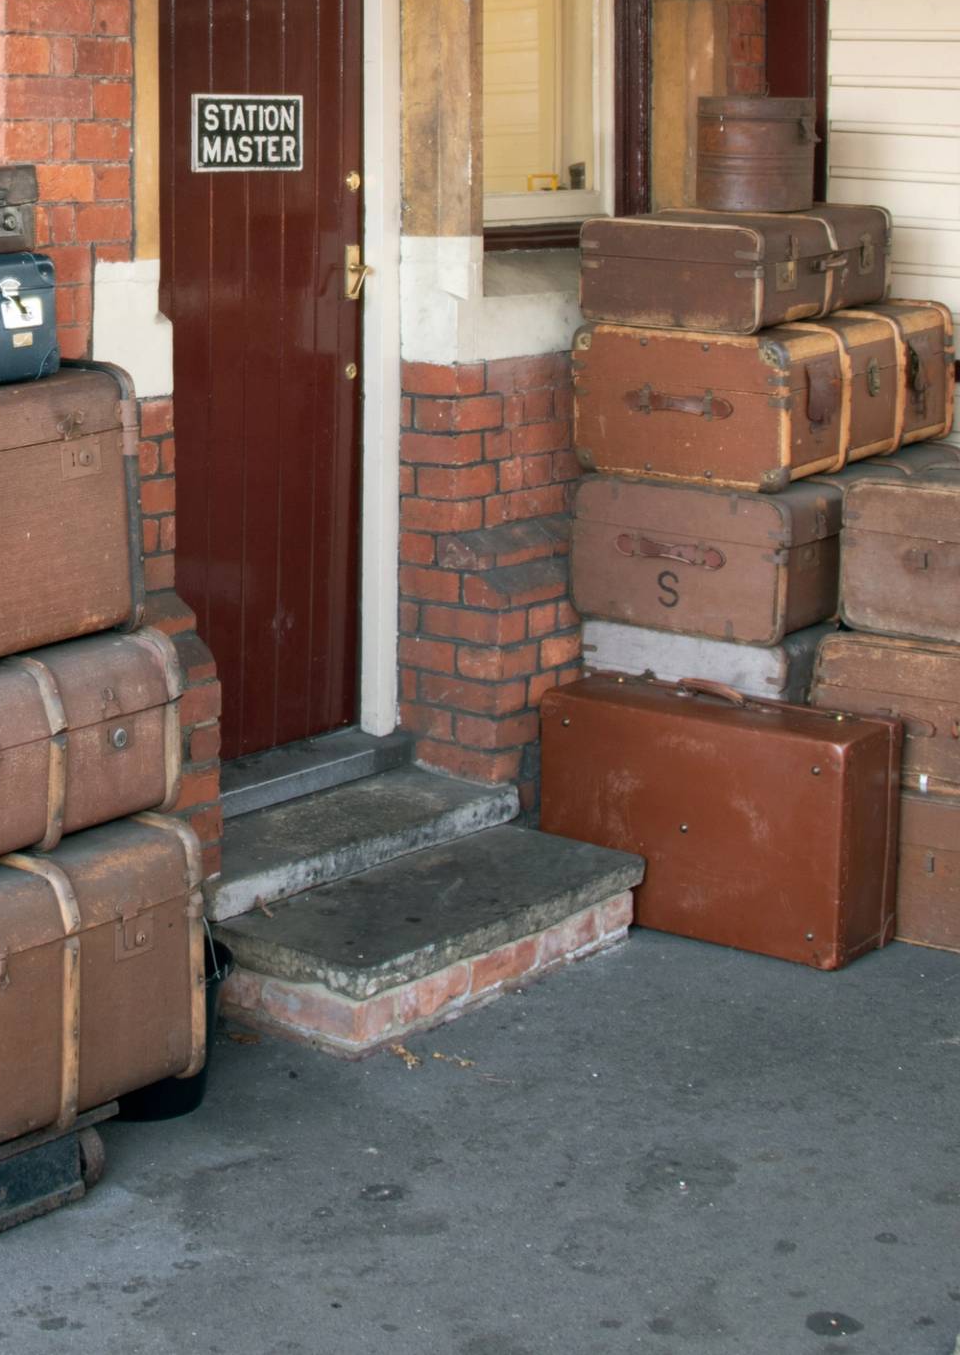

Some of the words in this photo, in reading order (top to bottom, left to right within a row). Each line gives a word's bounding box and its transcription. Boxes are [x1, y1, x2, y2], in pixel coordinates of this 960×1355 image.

[204, 104, 295, 131] STATION
[203, 136, 296, 163] MASTER
[657, 570, 679, 608] S
